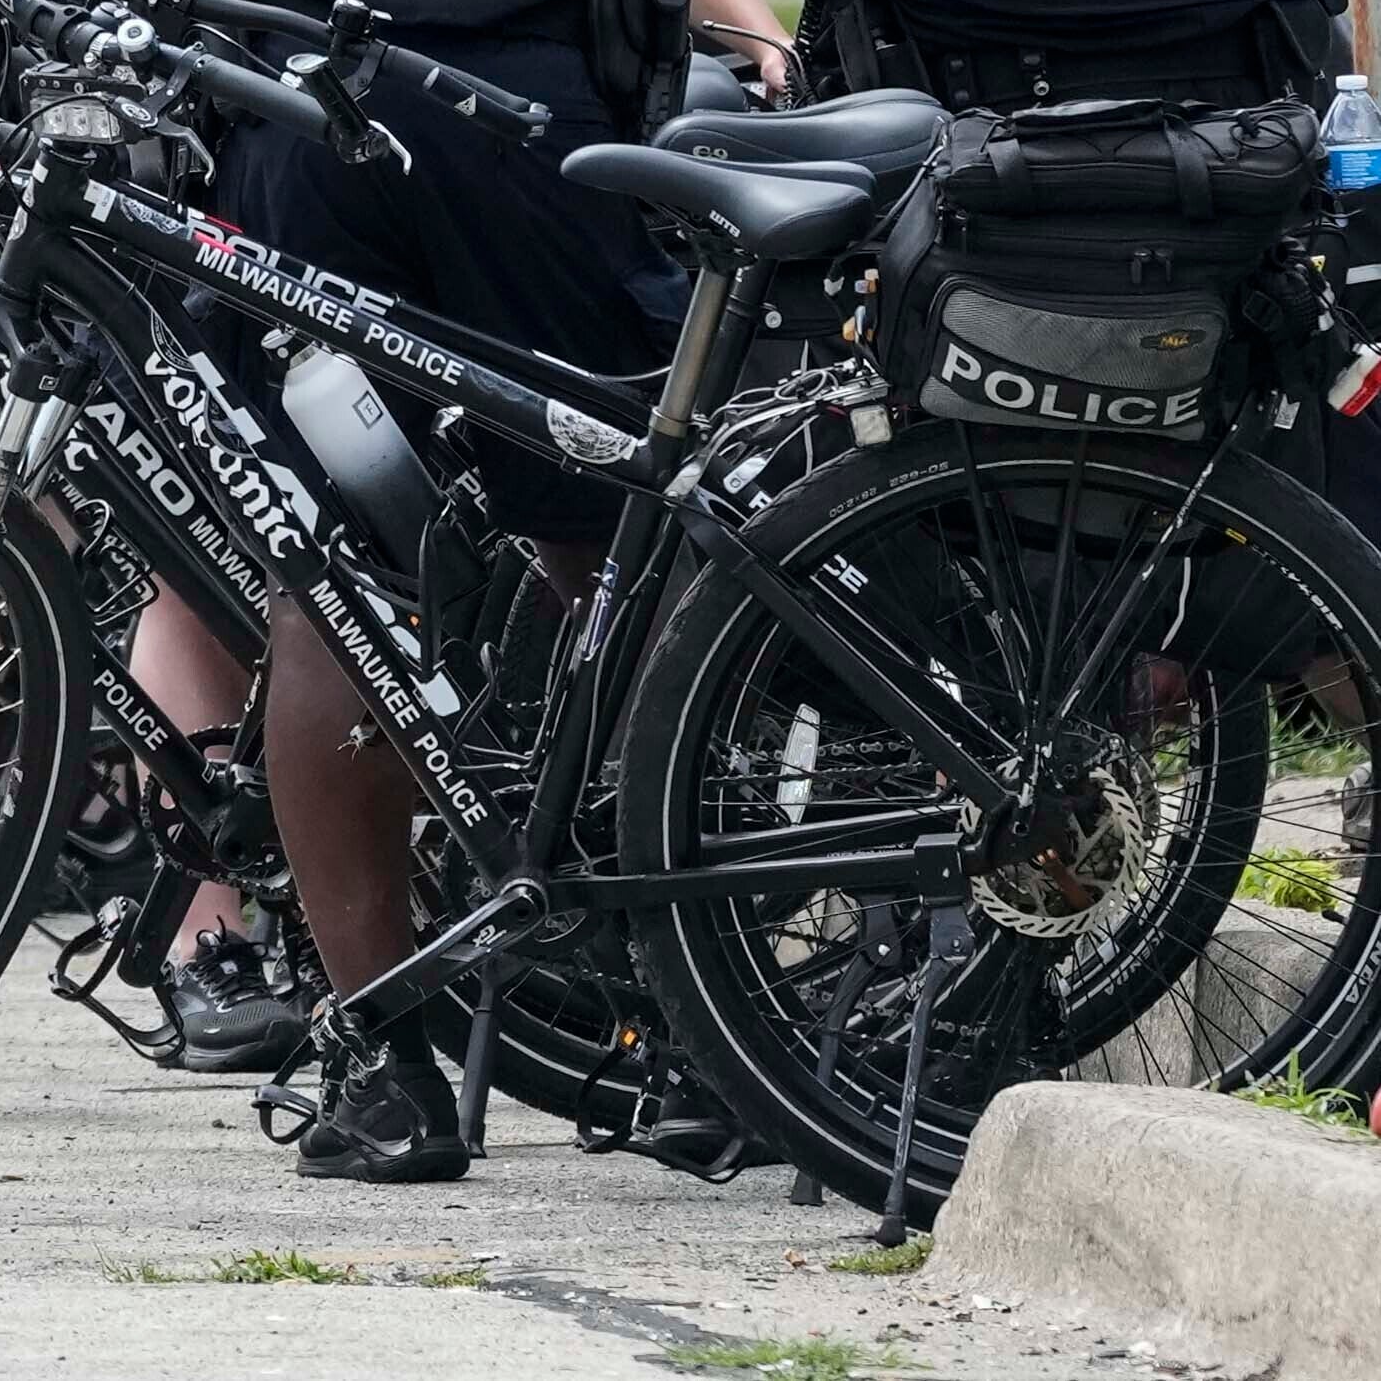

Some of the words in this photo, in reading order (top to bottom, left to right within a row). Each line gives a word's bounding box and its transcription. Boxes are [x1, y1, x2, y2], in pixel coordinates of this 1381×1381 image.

[708, 209, 742, 238] WTB
[195, 243, 356, 334] MILWAUKEE
[363, 322, 466, 387] POLICE
[941, 343, 1204, 427] POLICE
[83, 402, 196, 518] ARO
[187, 516, 271, 626] MILWAUK
[92, 668, 169, 753] POLICE
[308, 578, 419, 731] MILWAUKEE
[412, 732, 489, 828] POLICE
